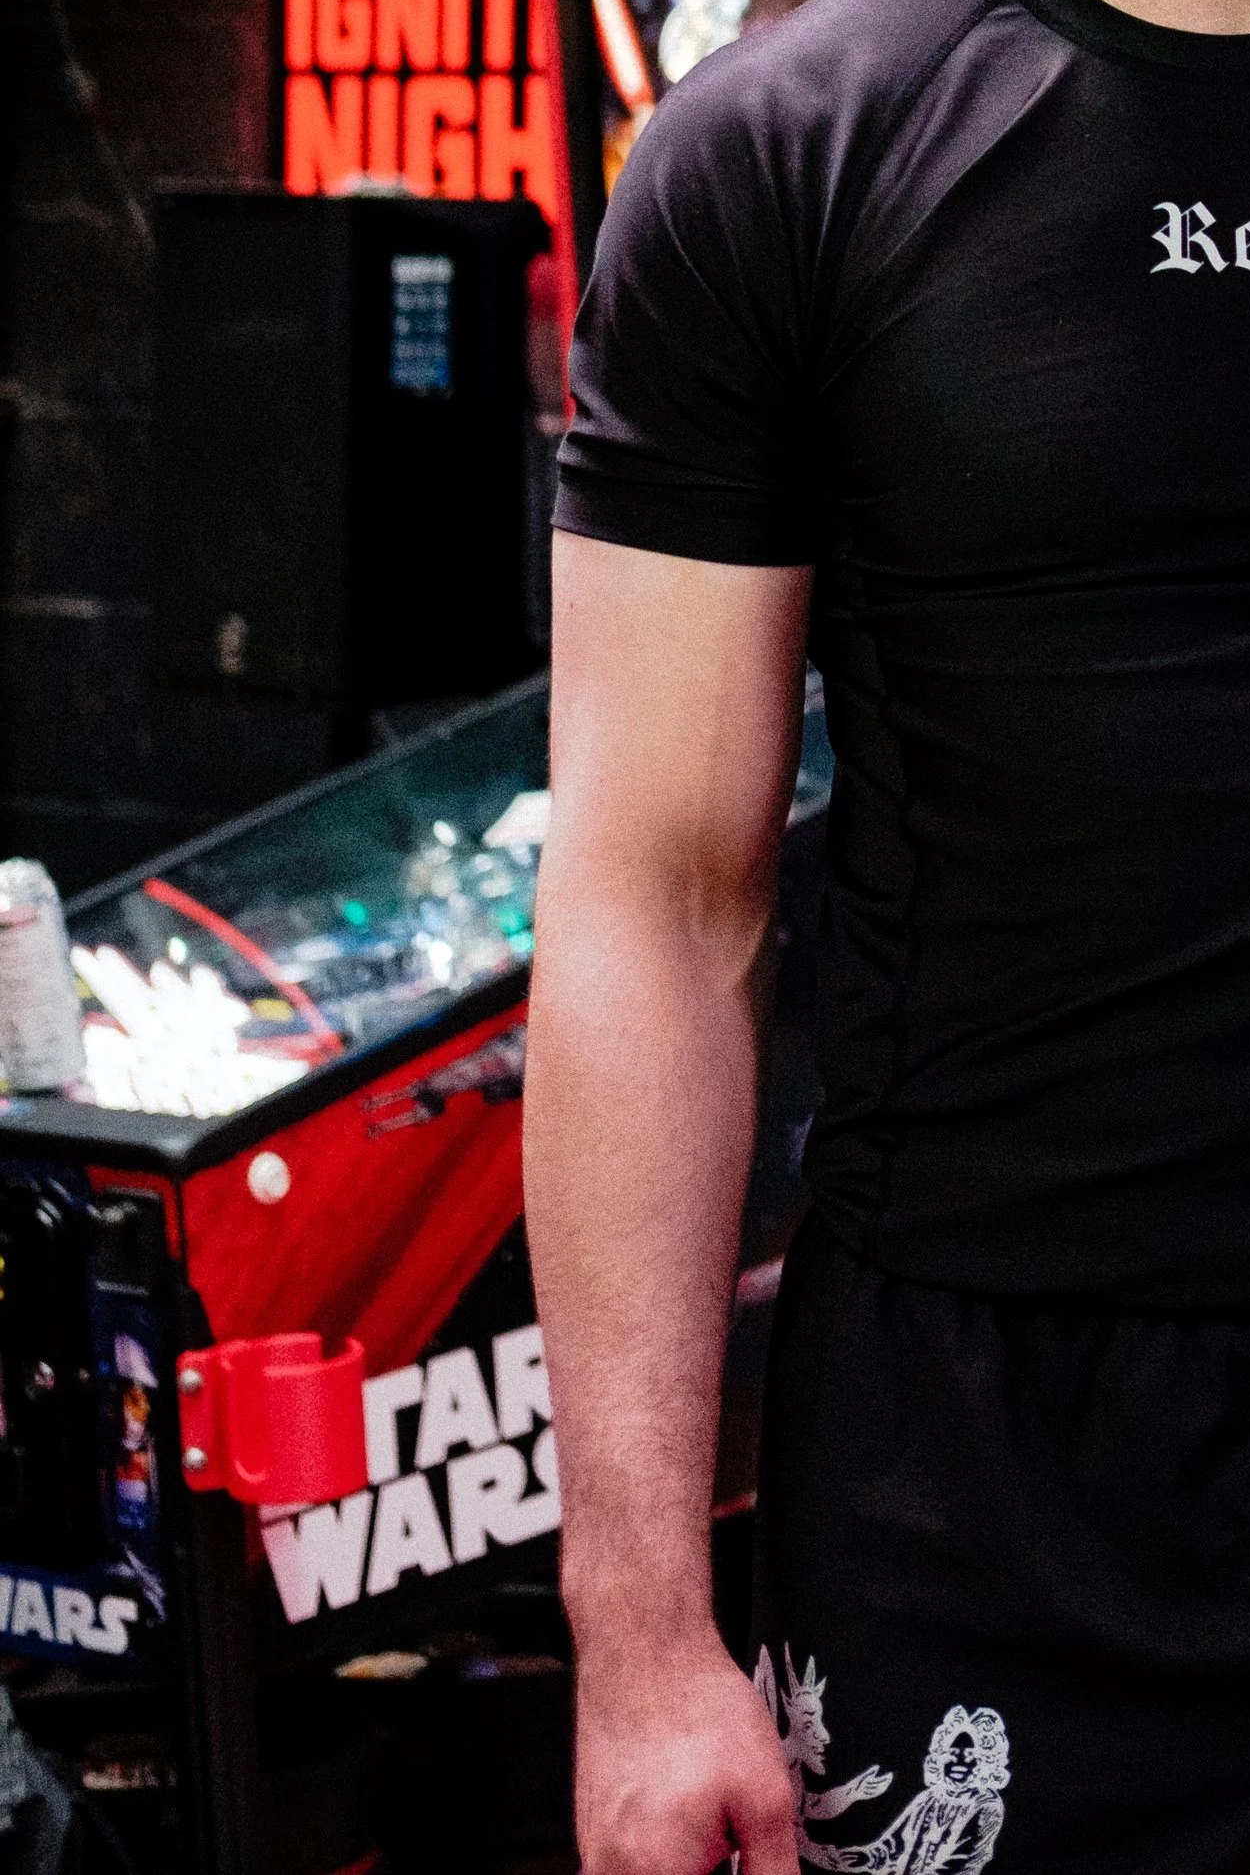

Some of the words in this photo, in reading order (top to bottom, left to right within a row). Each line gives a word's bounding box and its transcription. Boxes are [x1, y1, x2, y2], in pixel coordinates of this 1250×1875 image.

[284, 74, 558, 201] NIGH
[362, 1323, 556, 1487] TAR
[0, 1575, 139, 1655] ARS
